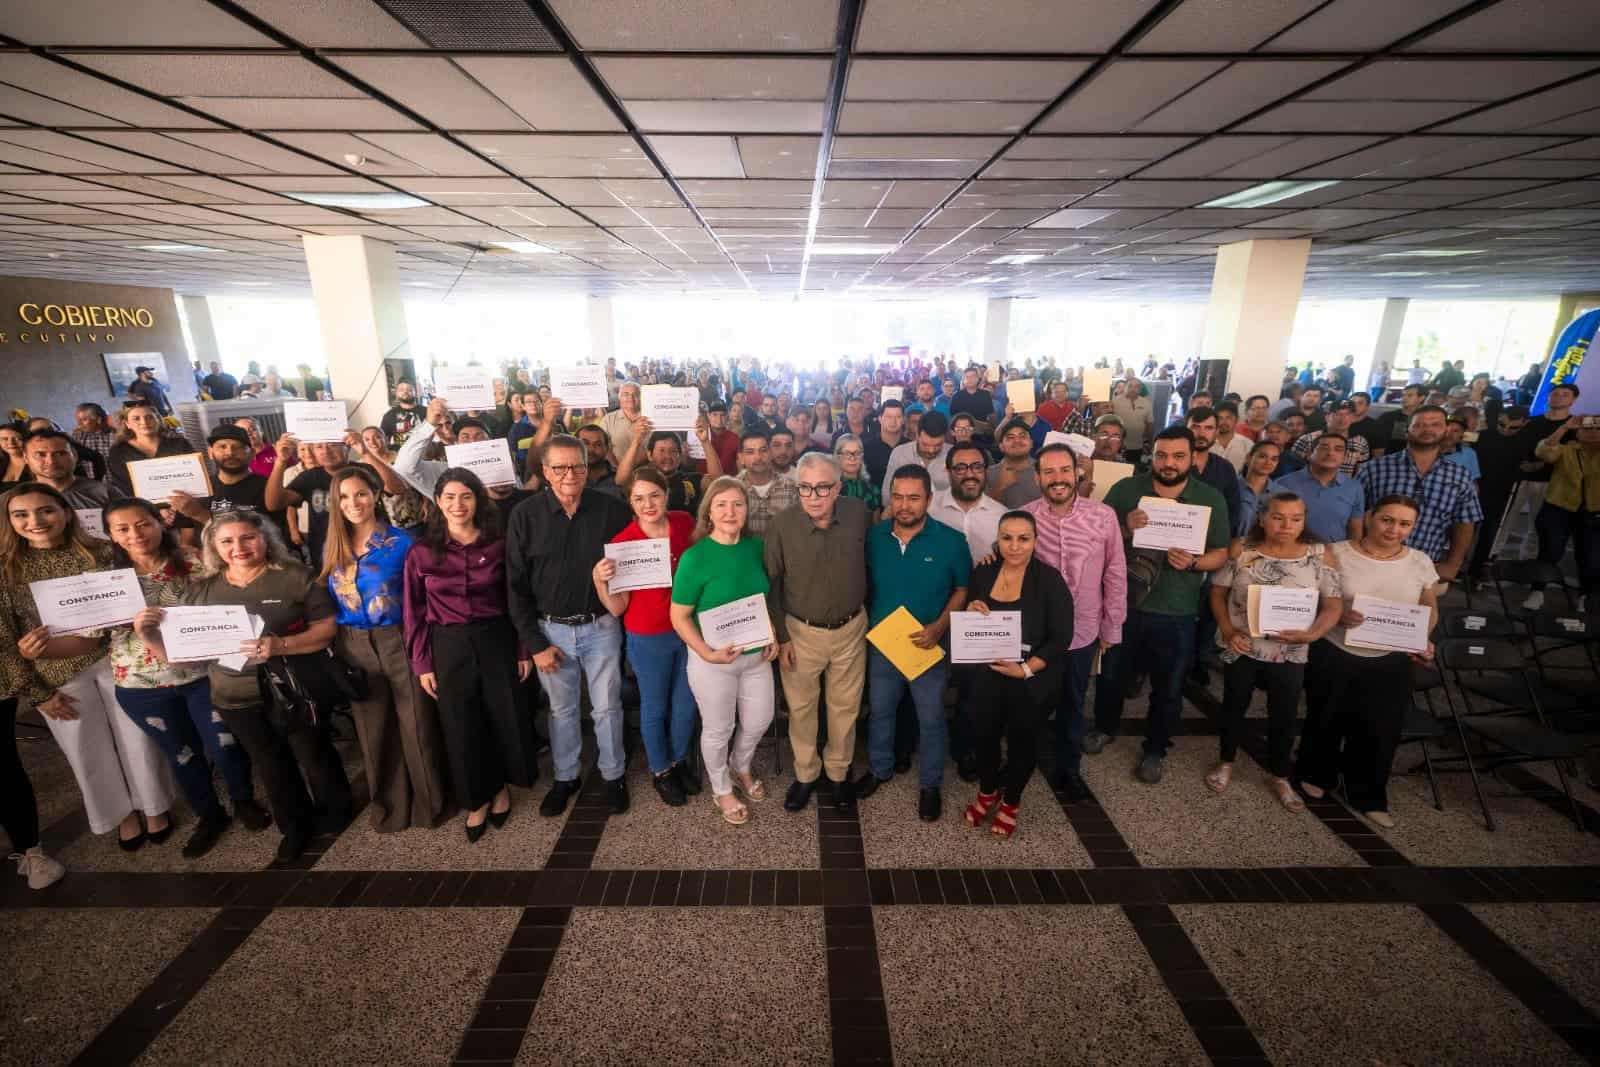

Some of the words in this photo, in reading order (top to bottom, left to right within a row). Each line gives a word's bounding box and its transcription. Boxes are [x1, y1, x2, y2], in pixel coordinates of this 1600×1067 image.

[19, 303, 154, 328] GOBIERNO
[1148, 520, 1193, 529] CONSTANCIA
[618, 557, 660, 567] CONSTANCIA
[59, 590, 126, 606] CONSTANCIA
[716, 615, 756, 631] CONSTANCIA
[1366, 616, 1416, 627] CONSTANCIA
[180, 624, 238, 634] CONSTANCIA
